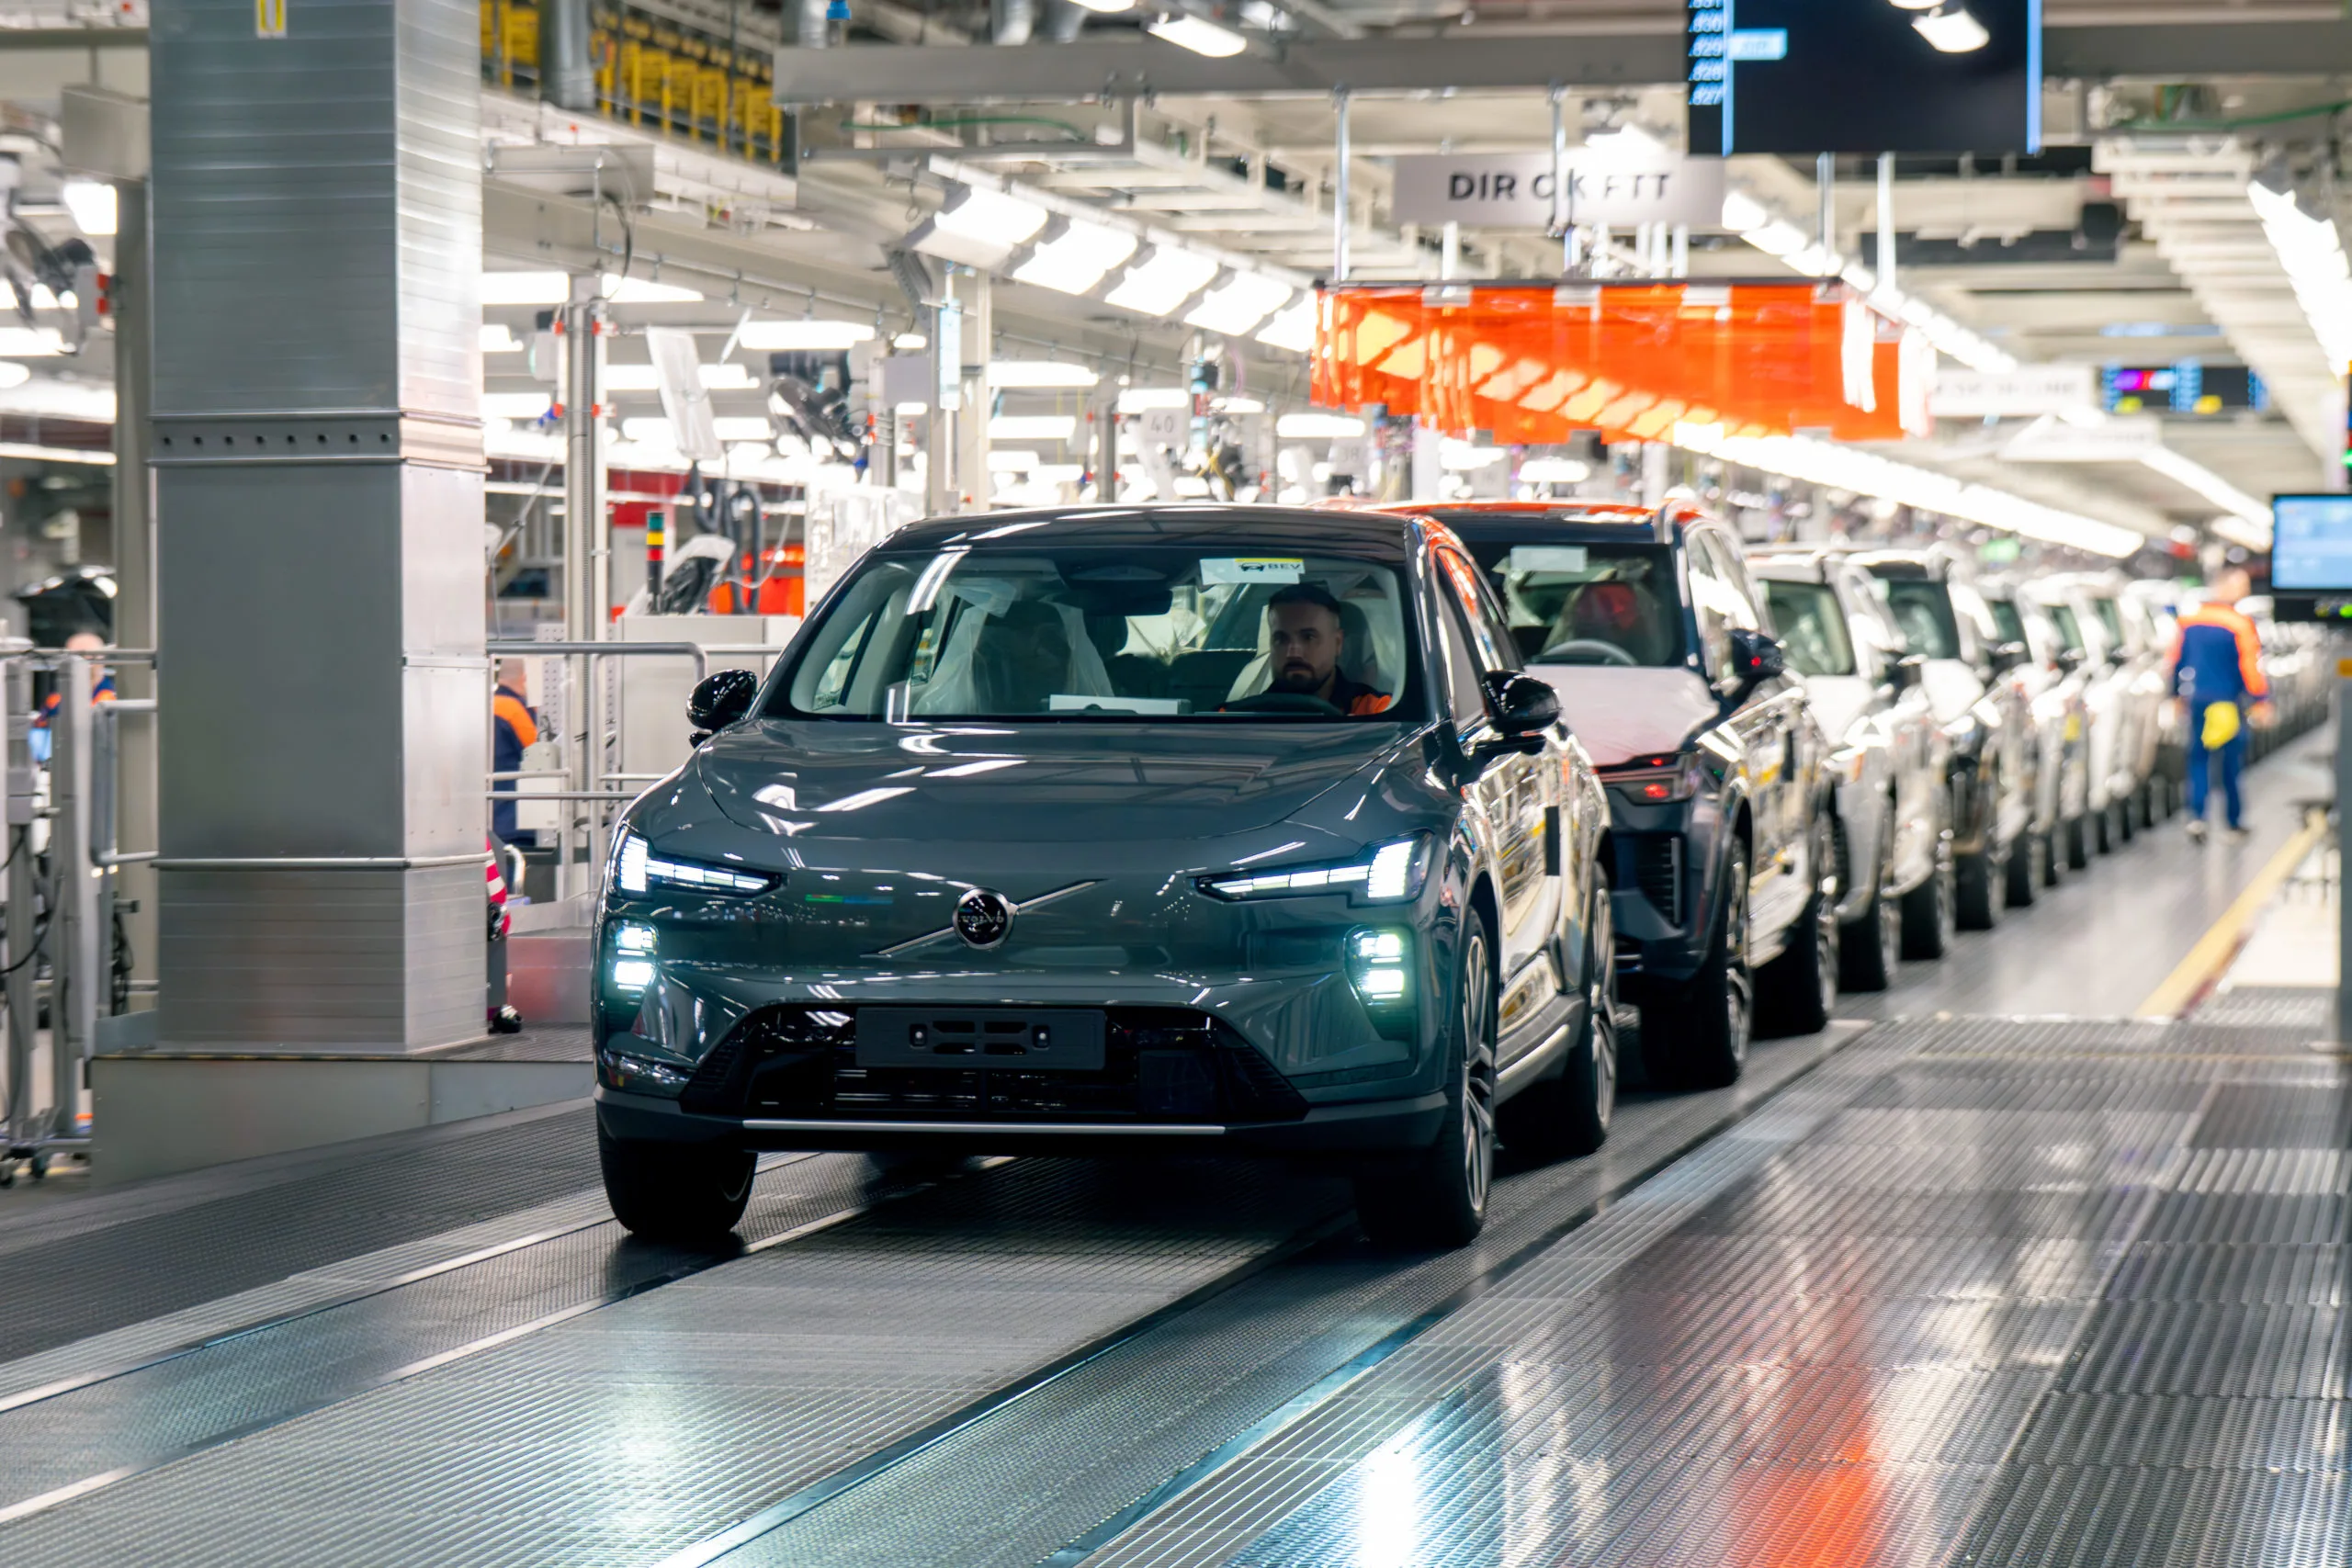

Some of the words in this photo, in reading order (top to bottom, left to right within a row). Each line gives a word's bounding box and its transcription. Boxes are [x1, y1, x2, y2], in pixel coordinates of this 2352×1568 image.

[1448, 172, 1517, 200] DIR
[1603, 173, 1671, 200] FTT
[1151, 415, 1175, 433] 40
[1268, 562, 1301, 570] BEV
